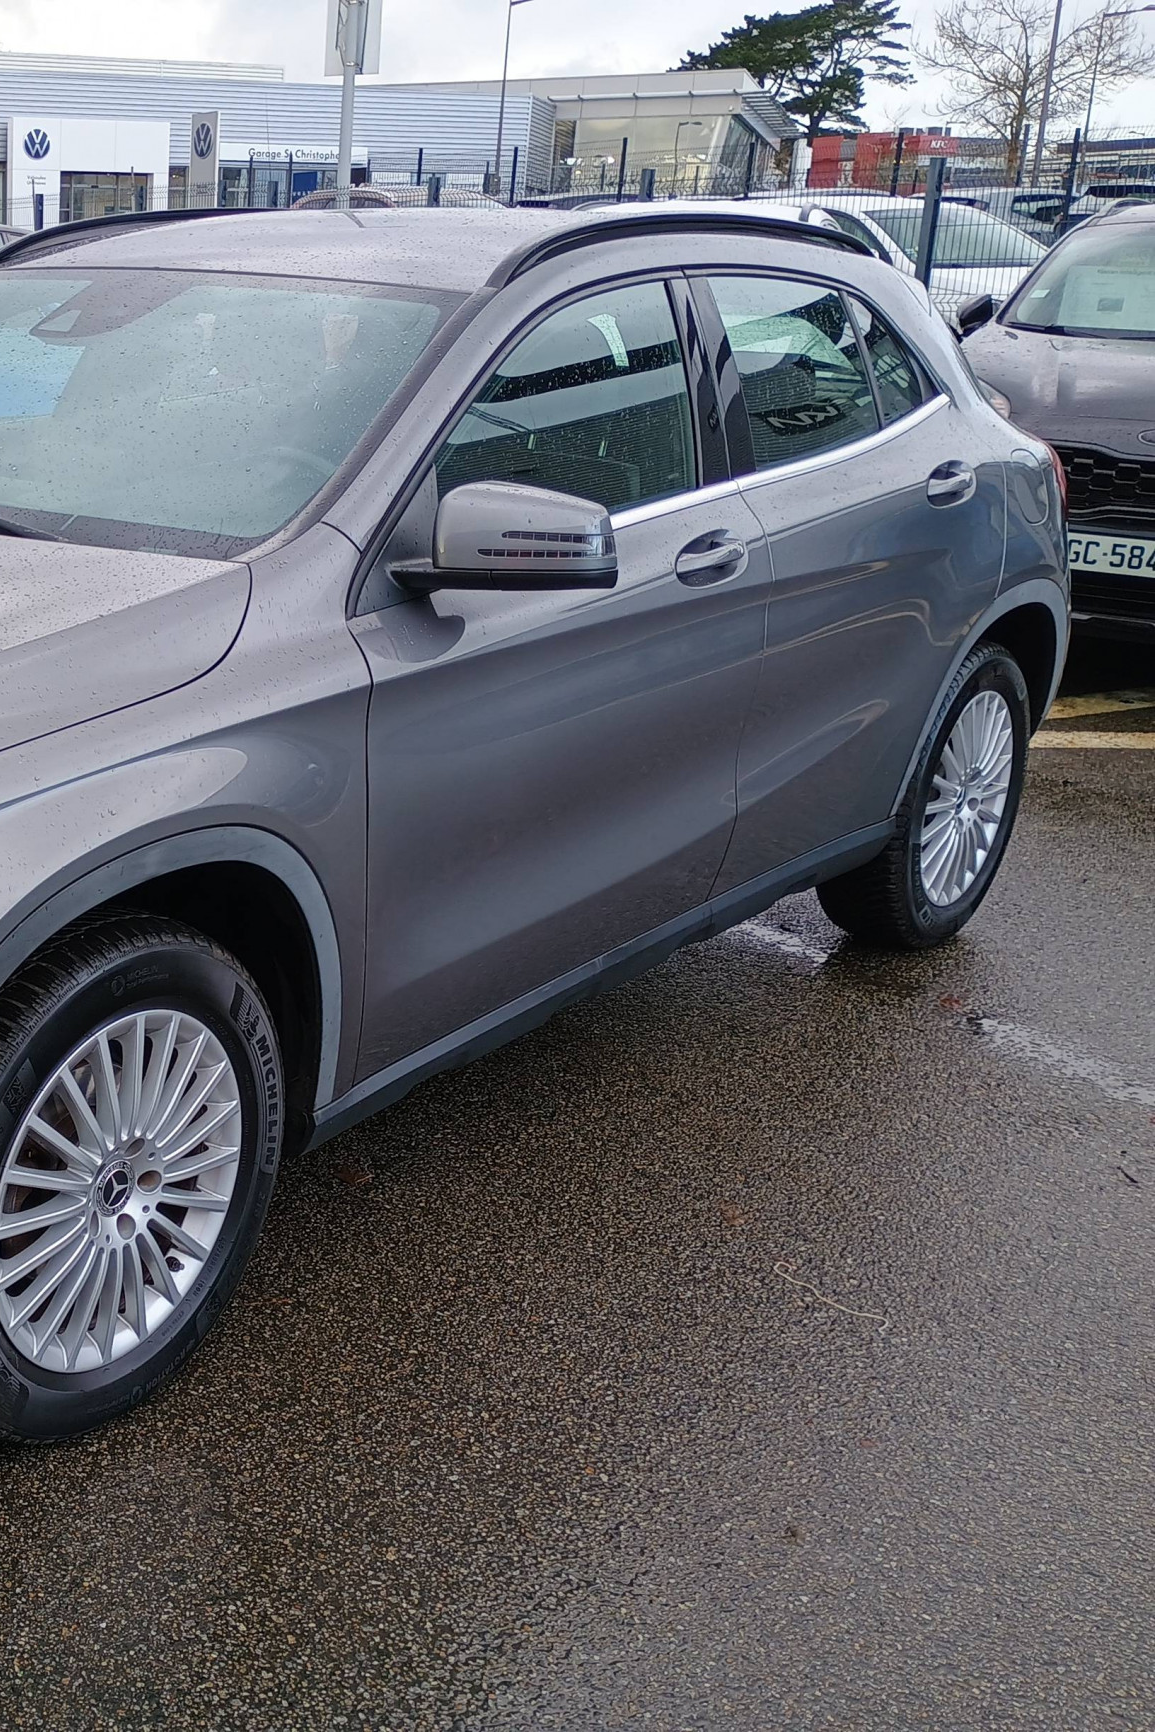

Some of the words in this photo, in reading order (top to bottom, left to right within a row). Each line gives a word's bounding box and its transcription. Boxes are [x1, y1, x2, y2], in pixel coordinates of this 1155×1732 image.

[889, 139, 908, 150] KC
[248, 147, 282, 160] Garage
[254, 1034, 279, 1167] MICHELIN
